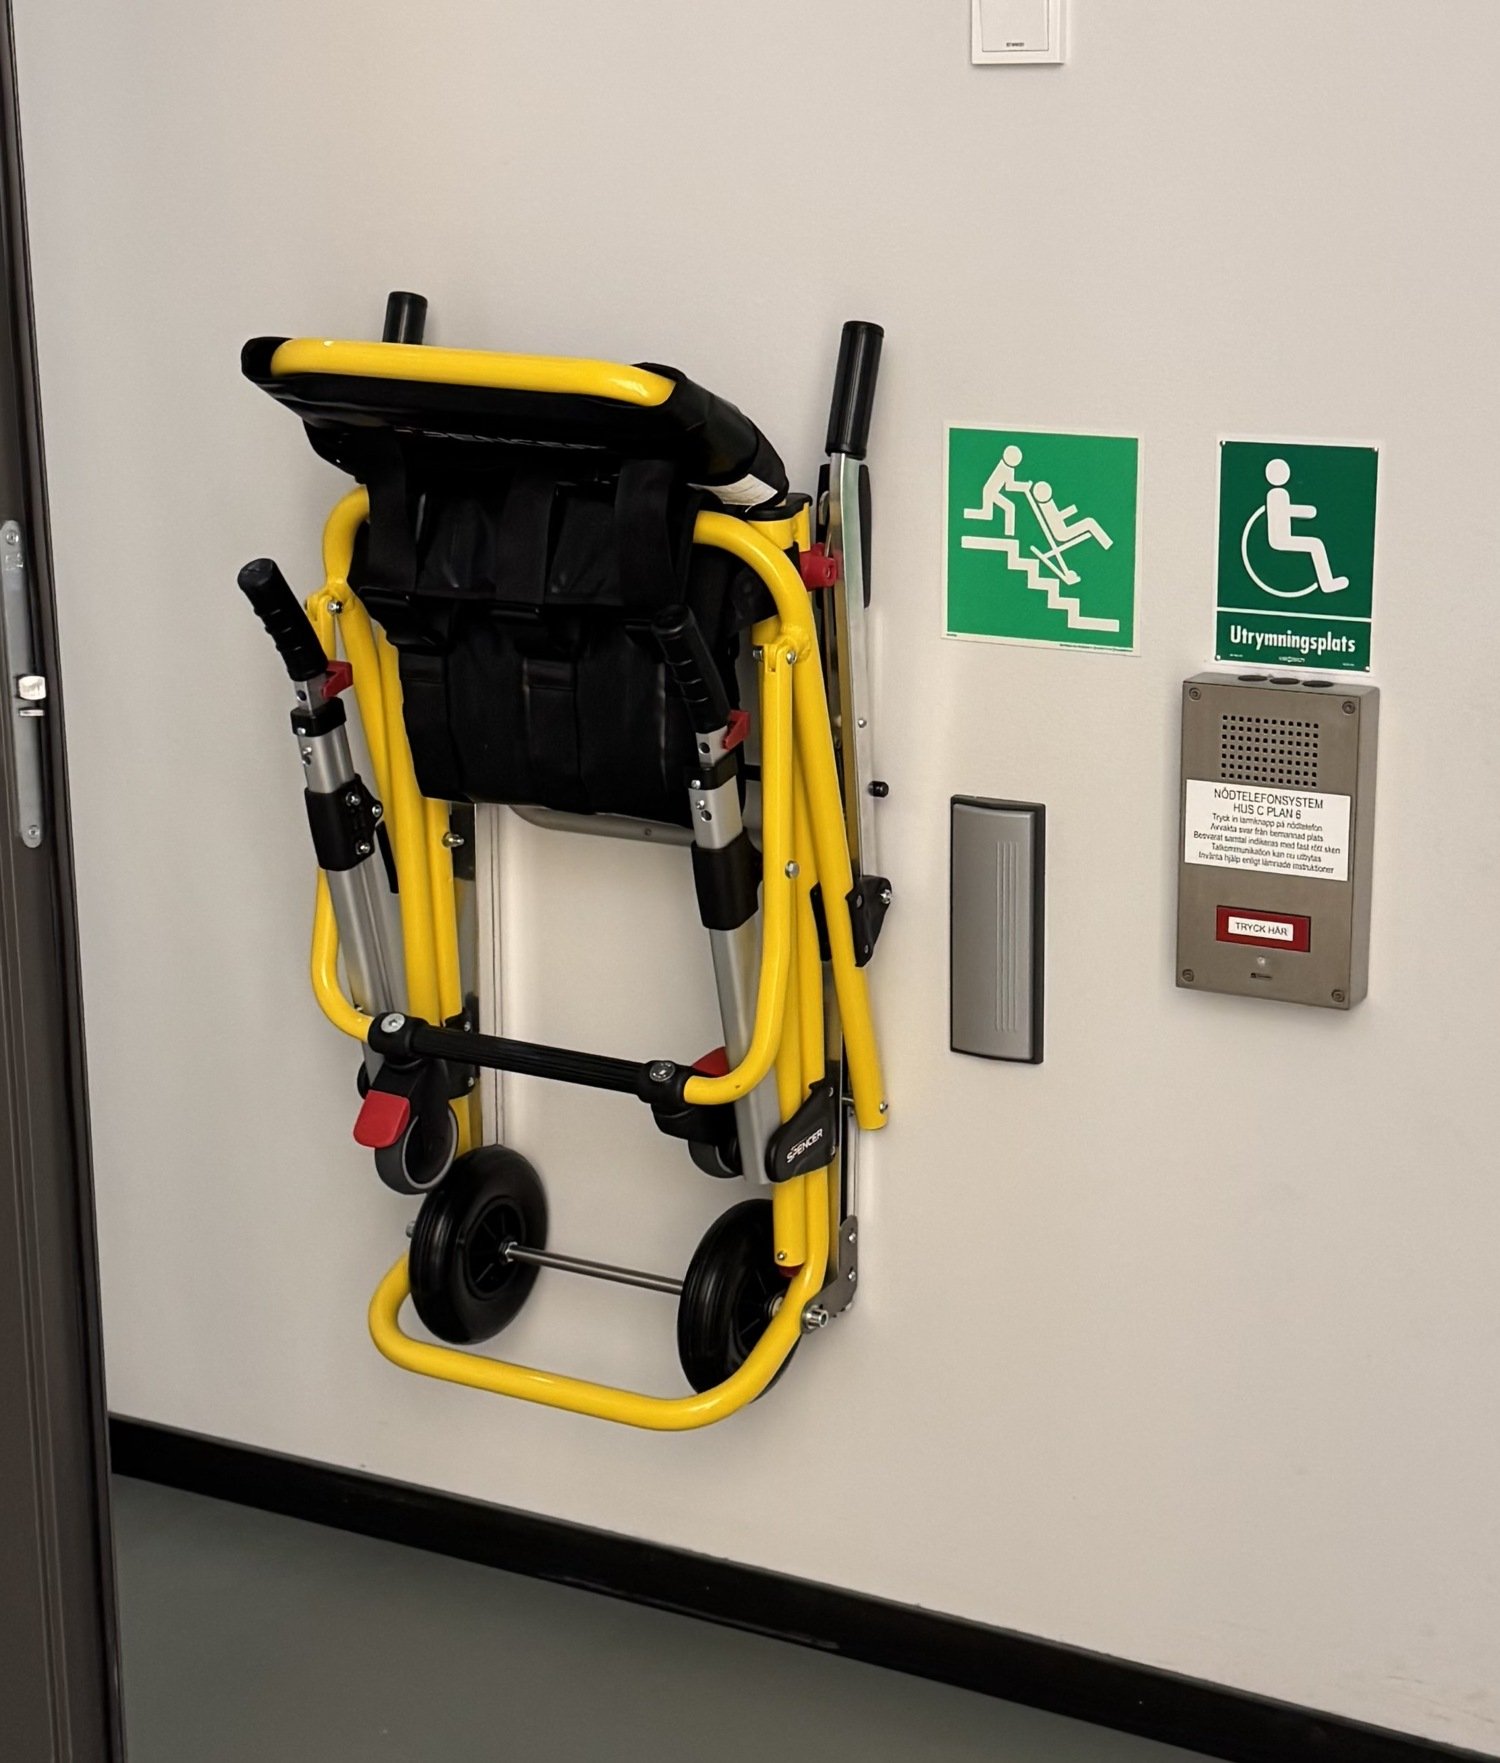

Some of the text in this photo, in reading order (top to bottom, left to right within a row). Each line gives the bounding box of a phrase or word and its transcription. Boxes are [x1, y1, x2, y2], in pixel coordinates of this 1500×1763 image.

[1230, 624, 1356, 655] Utrymningsplats
[1214, 787, 1323, 809] NÖDTELEFONSYSTEM
[1233, 803, 1302, 819] HUS C PLAN 6
[1212, 813, 1230, 822] Tryck
[1240, 816, 1274, 827] larmknapp
[1287, 821, 1322, 832] nödtelefon
[1193, 830, 1223, 840] Besvarat
[1224, 834, 1247, 844] samtal
[1280, 841, 1295, 849] med
[1297, 842, 1309, 850] fast
[1210, 823, 1323, 842] Avvakta svar från bemannad plats
[1211, 842, 1270, 857] Talkommunikation
[1272, 849, 1285, 857] kan
[1224, 854, 1240, 864] hjälp
[1242, 856, 1261, 867] enligt
[1262, 857, 1291, 869] lämnade
[1292, 862, 1334, 874] instruktioner
[1235, 921, 1288, 937] TRYCK HÄR
